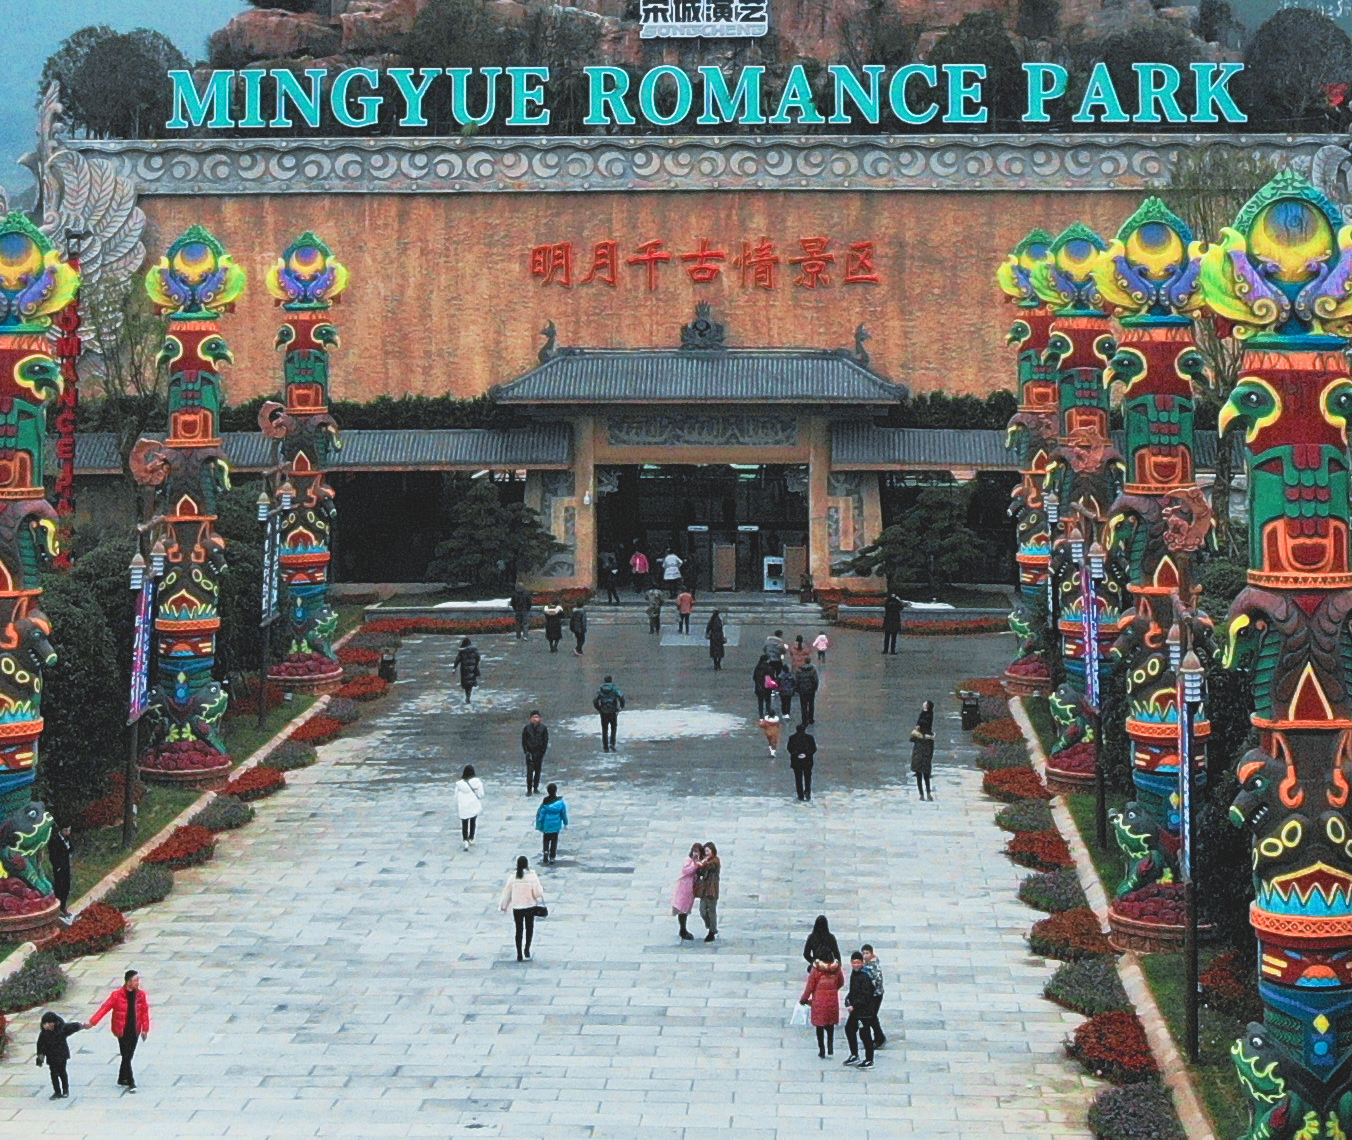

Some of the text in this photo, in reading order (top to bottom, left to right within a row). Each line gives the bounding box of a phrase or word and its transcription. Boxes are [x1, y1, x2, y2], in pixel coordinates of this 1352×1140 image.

[166, 60, 1248, 128] MINGYUE ROMANCE PARK
[528, 238, 886, 290] 明月千古情景区
[54, 304, 82, 460] OMANCE
